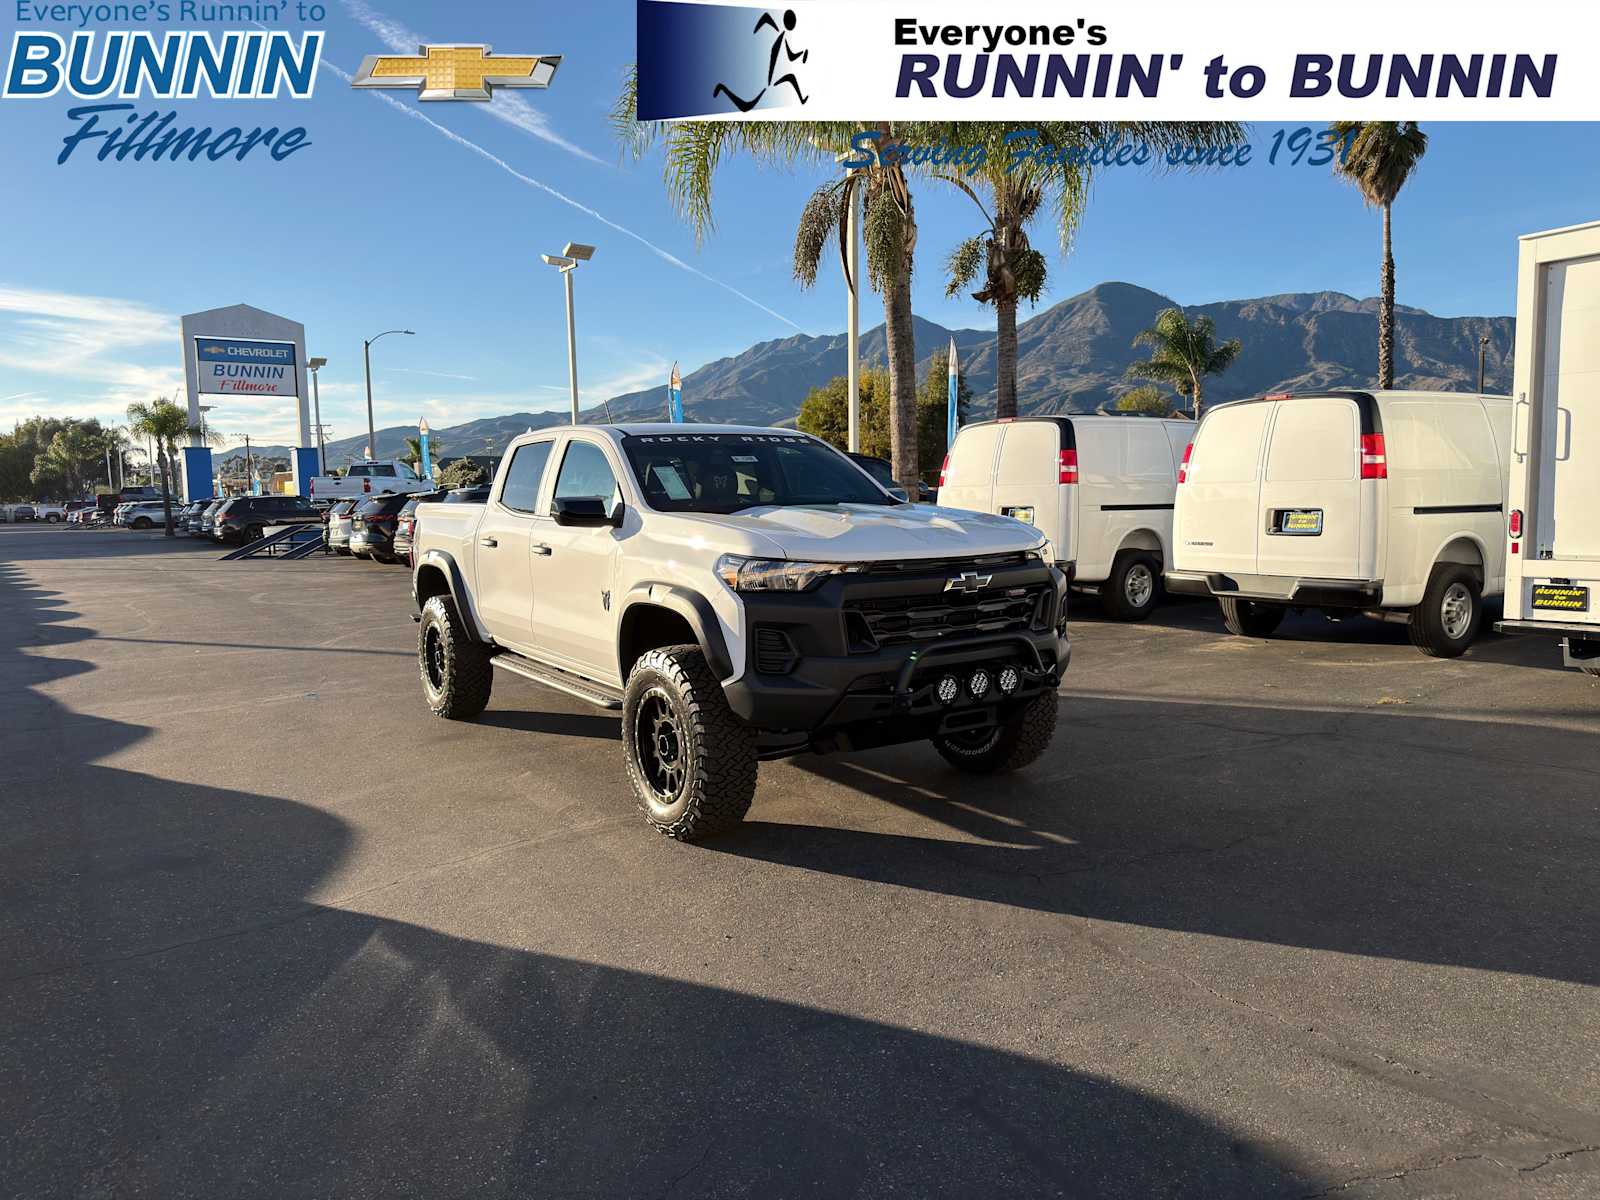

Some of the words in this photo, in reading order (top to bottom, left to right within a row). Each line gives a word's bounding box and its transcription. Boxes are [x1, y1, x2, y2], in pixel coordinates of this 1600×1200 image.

[227, 346, 289, 358] CHEVROLET
[213, 364, 285, 379] BUNNIN
[219, 379, 278, 392] Fillmore
